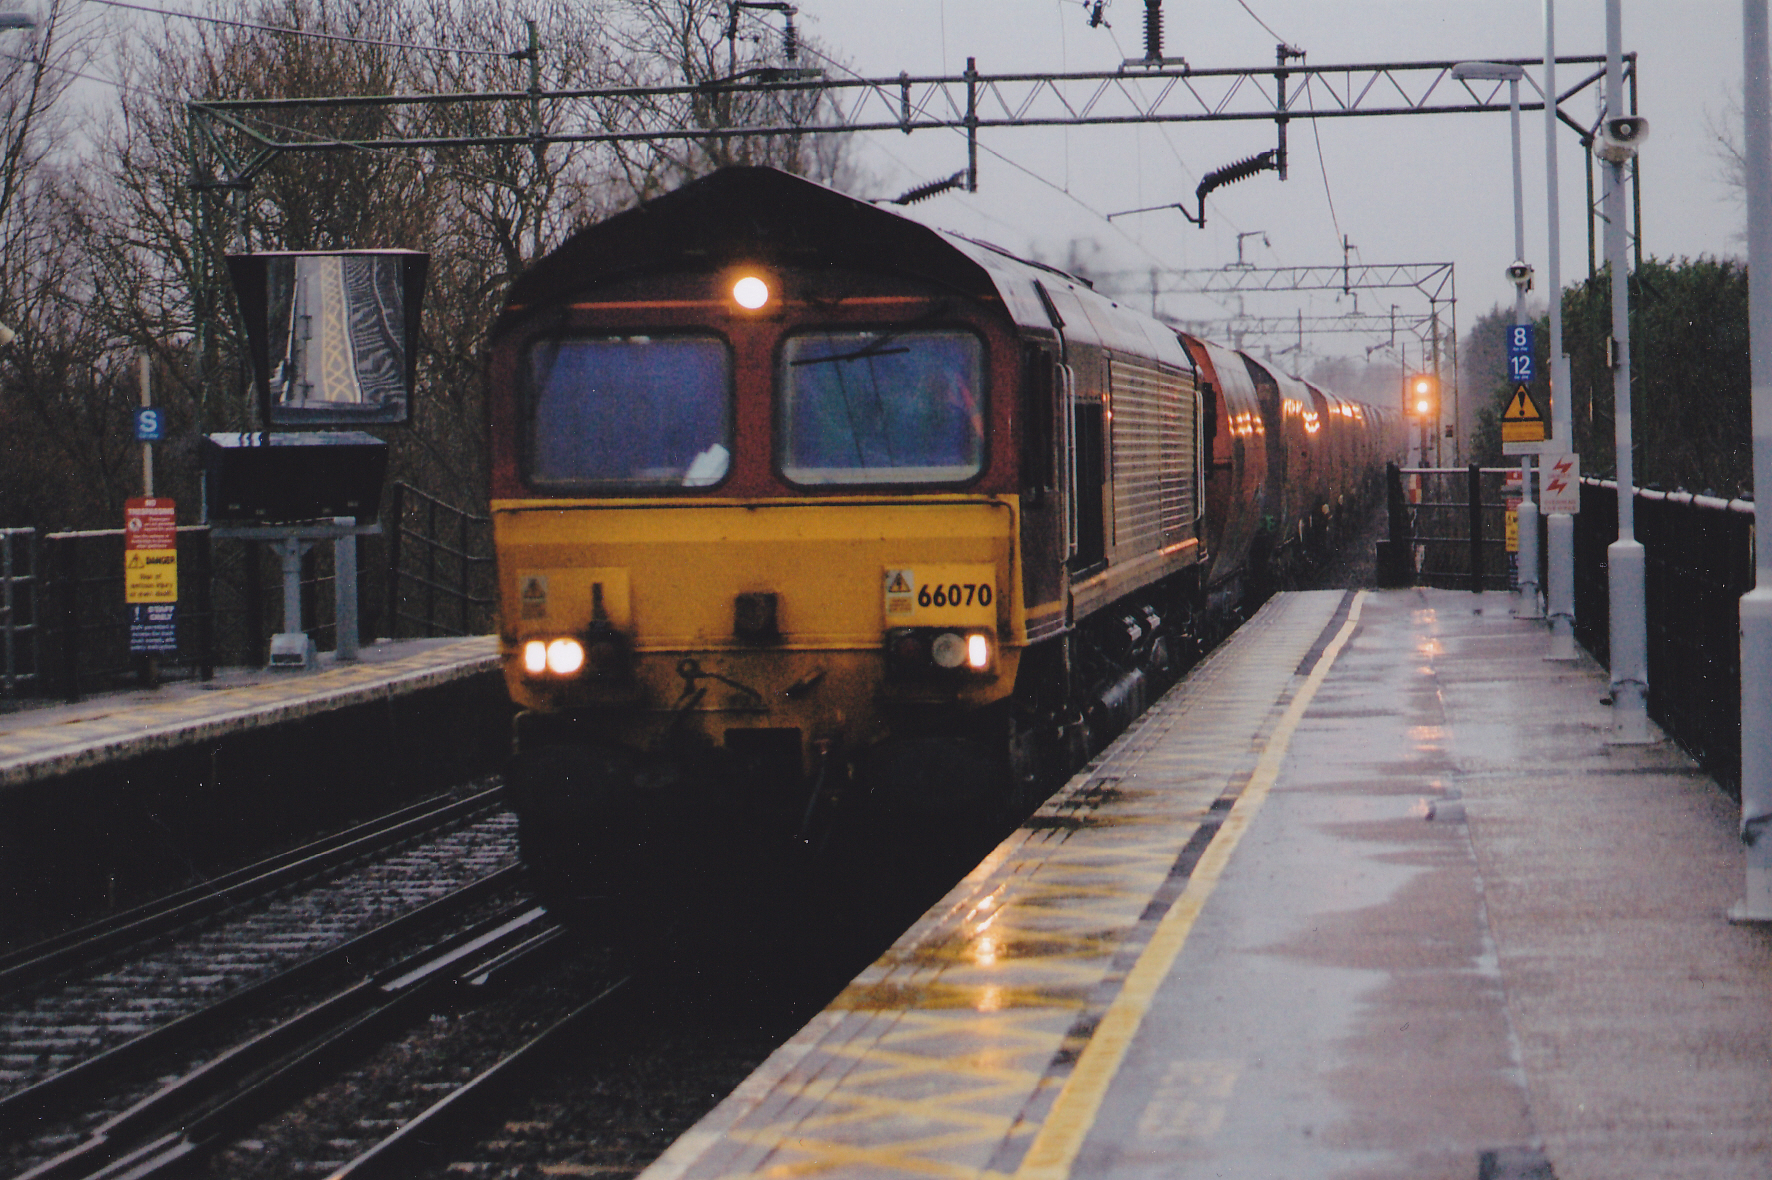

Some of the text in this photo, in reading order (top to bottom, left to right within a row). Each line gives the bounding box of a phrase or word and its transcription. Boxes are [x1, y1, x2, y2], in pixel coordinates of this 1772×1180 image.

[1514, 327, 1527, 347] 8
[1511, 355, 1531, 375] 12
[139, 410, 158, 433] S
[146, 556, 175, 565] DANGER
[918, 584, 992, 607] 66070
[147, 605, 175, 613] STAFF
